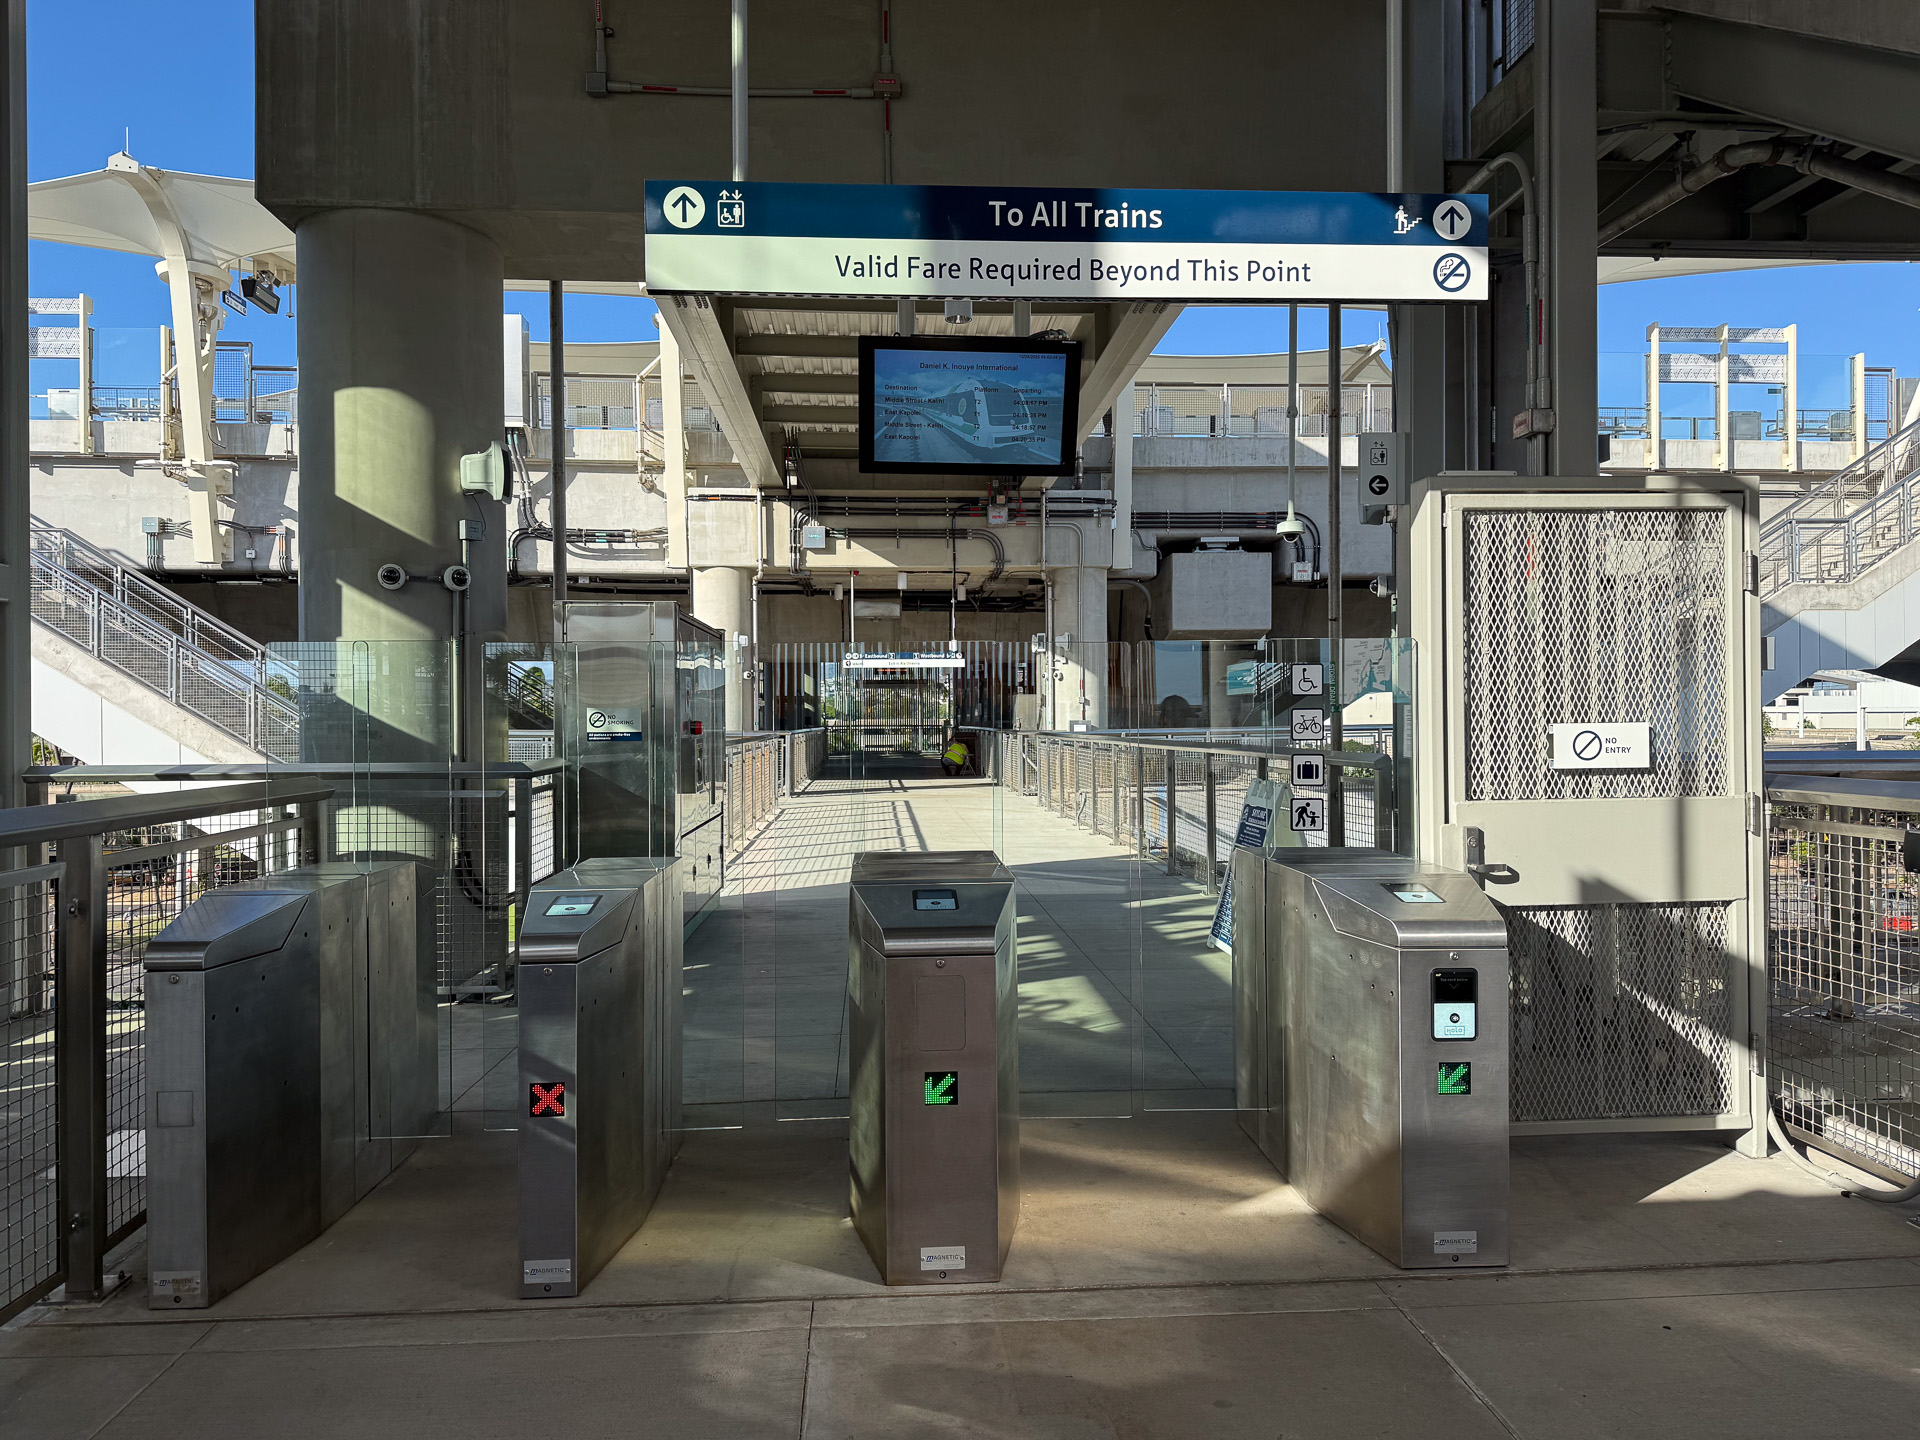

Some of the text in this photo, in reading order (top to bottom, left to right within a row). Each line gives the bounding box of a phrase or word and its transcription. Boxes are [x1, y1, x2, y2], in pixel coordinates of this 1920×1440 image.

[988, 199, 1163, 229] To All Trains
[834, 255, 1311, 287] Valid Fare Required Beyond This Point
[919, 362, 1019, 372] Daniel K. Inouye International
[1013, 387, 1042, 395] Departing
[898, 410, 921, 418] Kapolei
[898, 434, 921, 442] Kapolei
